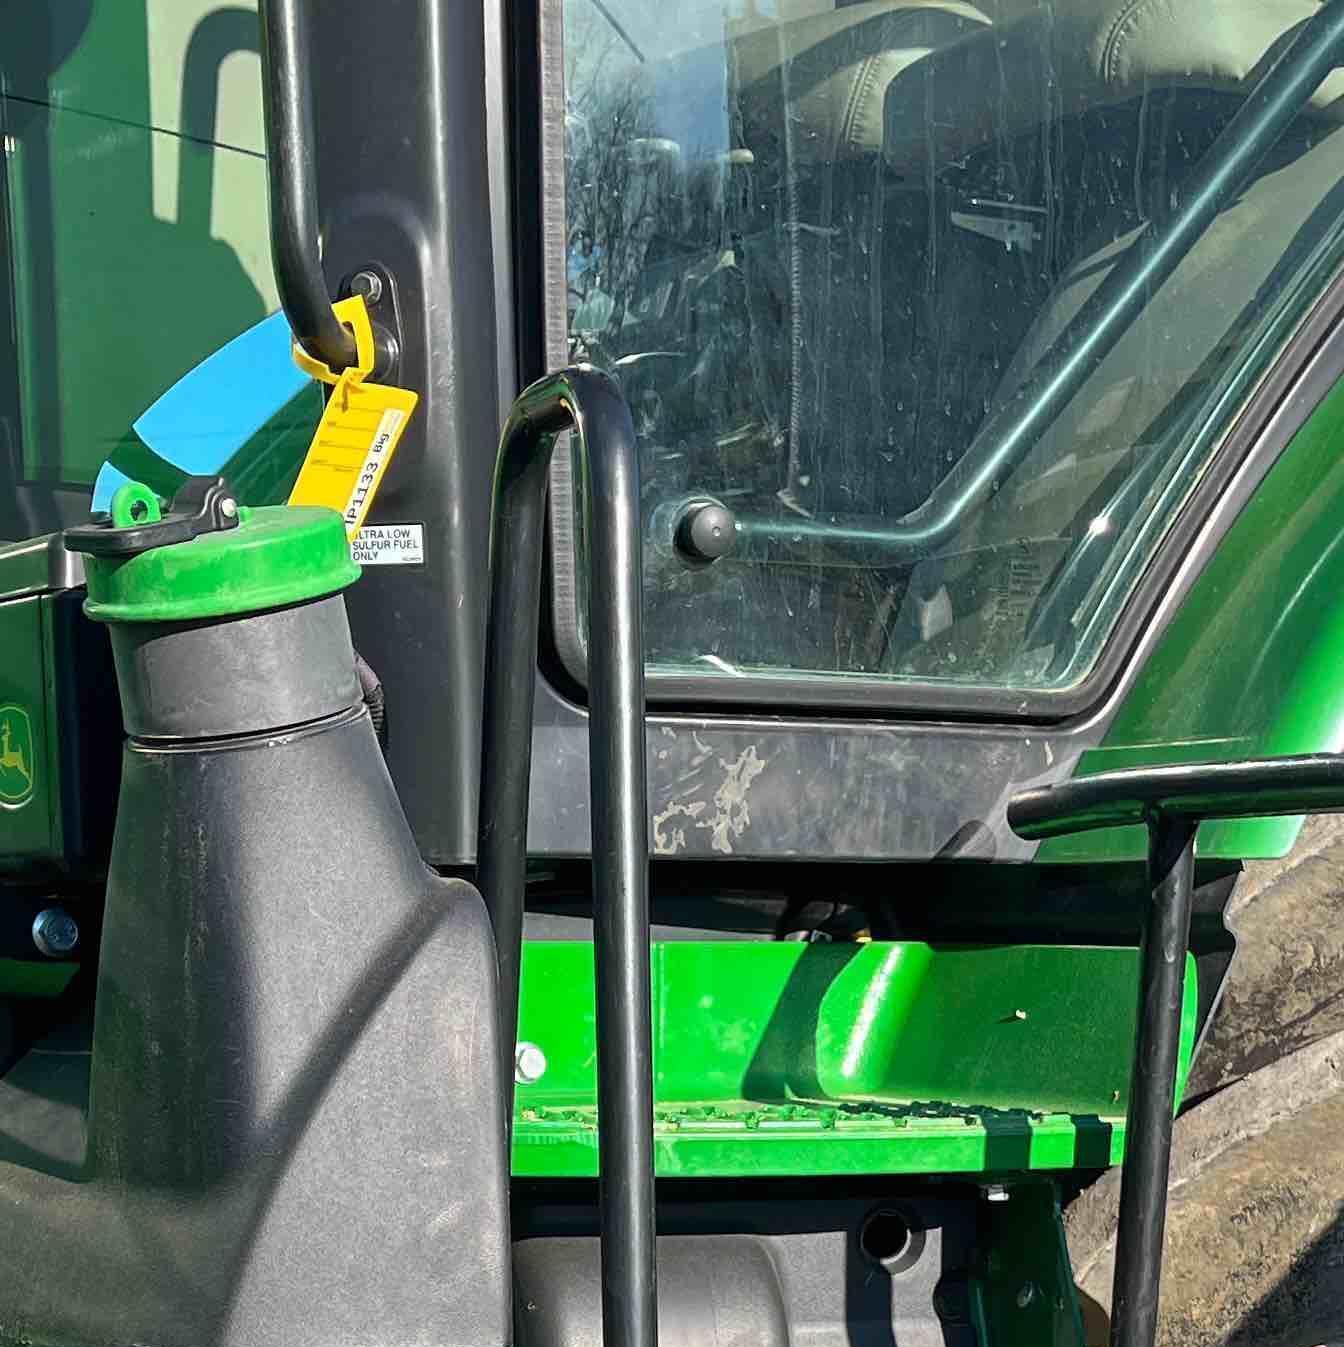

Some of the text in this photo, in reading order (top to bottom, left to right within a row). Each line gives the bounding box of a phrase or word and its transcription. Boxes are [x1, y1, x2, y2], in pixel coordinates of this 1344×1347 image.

[354, 528, 411, 540] LTRA LOW
[352, 538, 419, 551] SULFUR FUEL
[352, 551, 379, 562] ONLY
